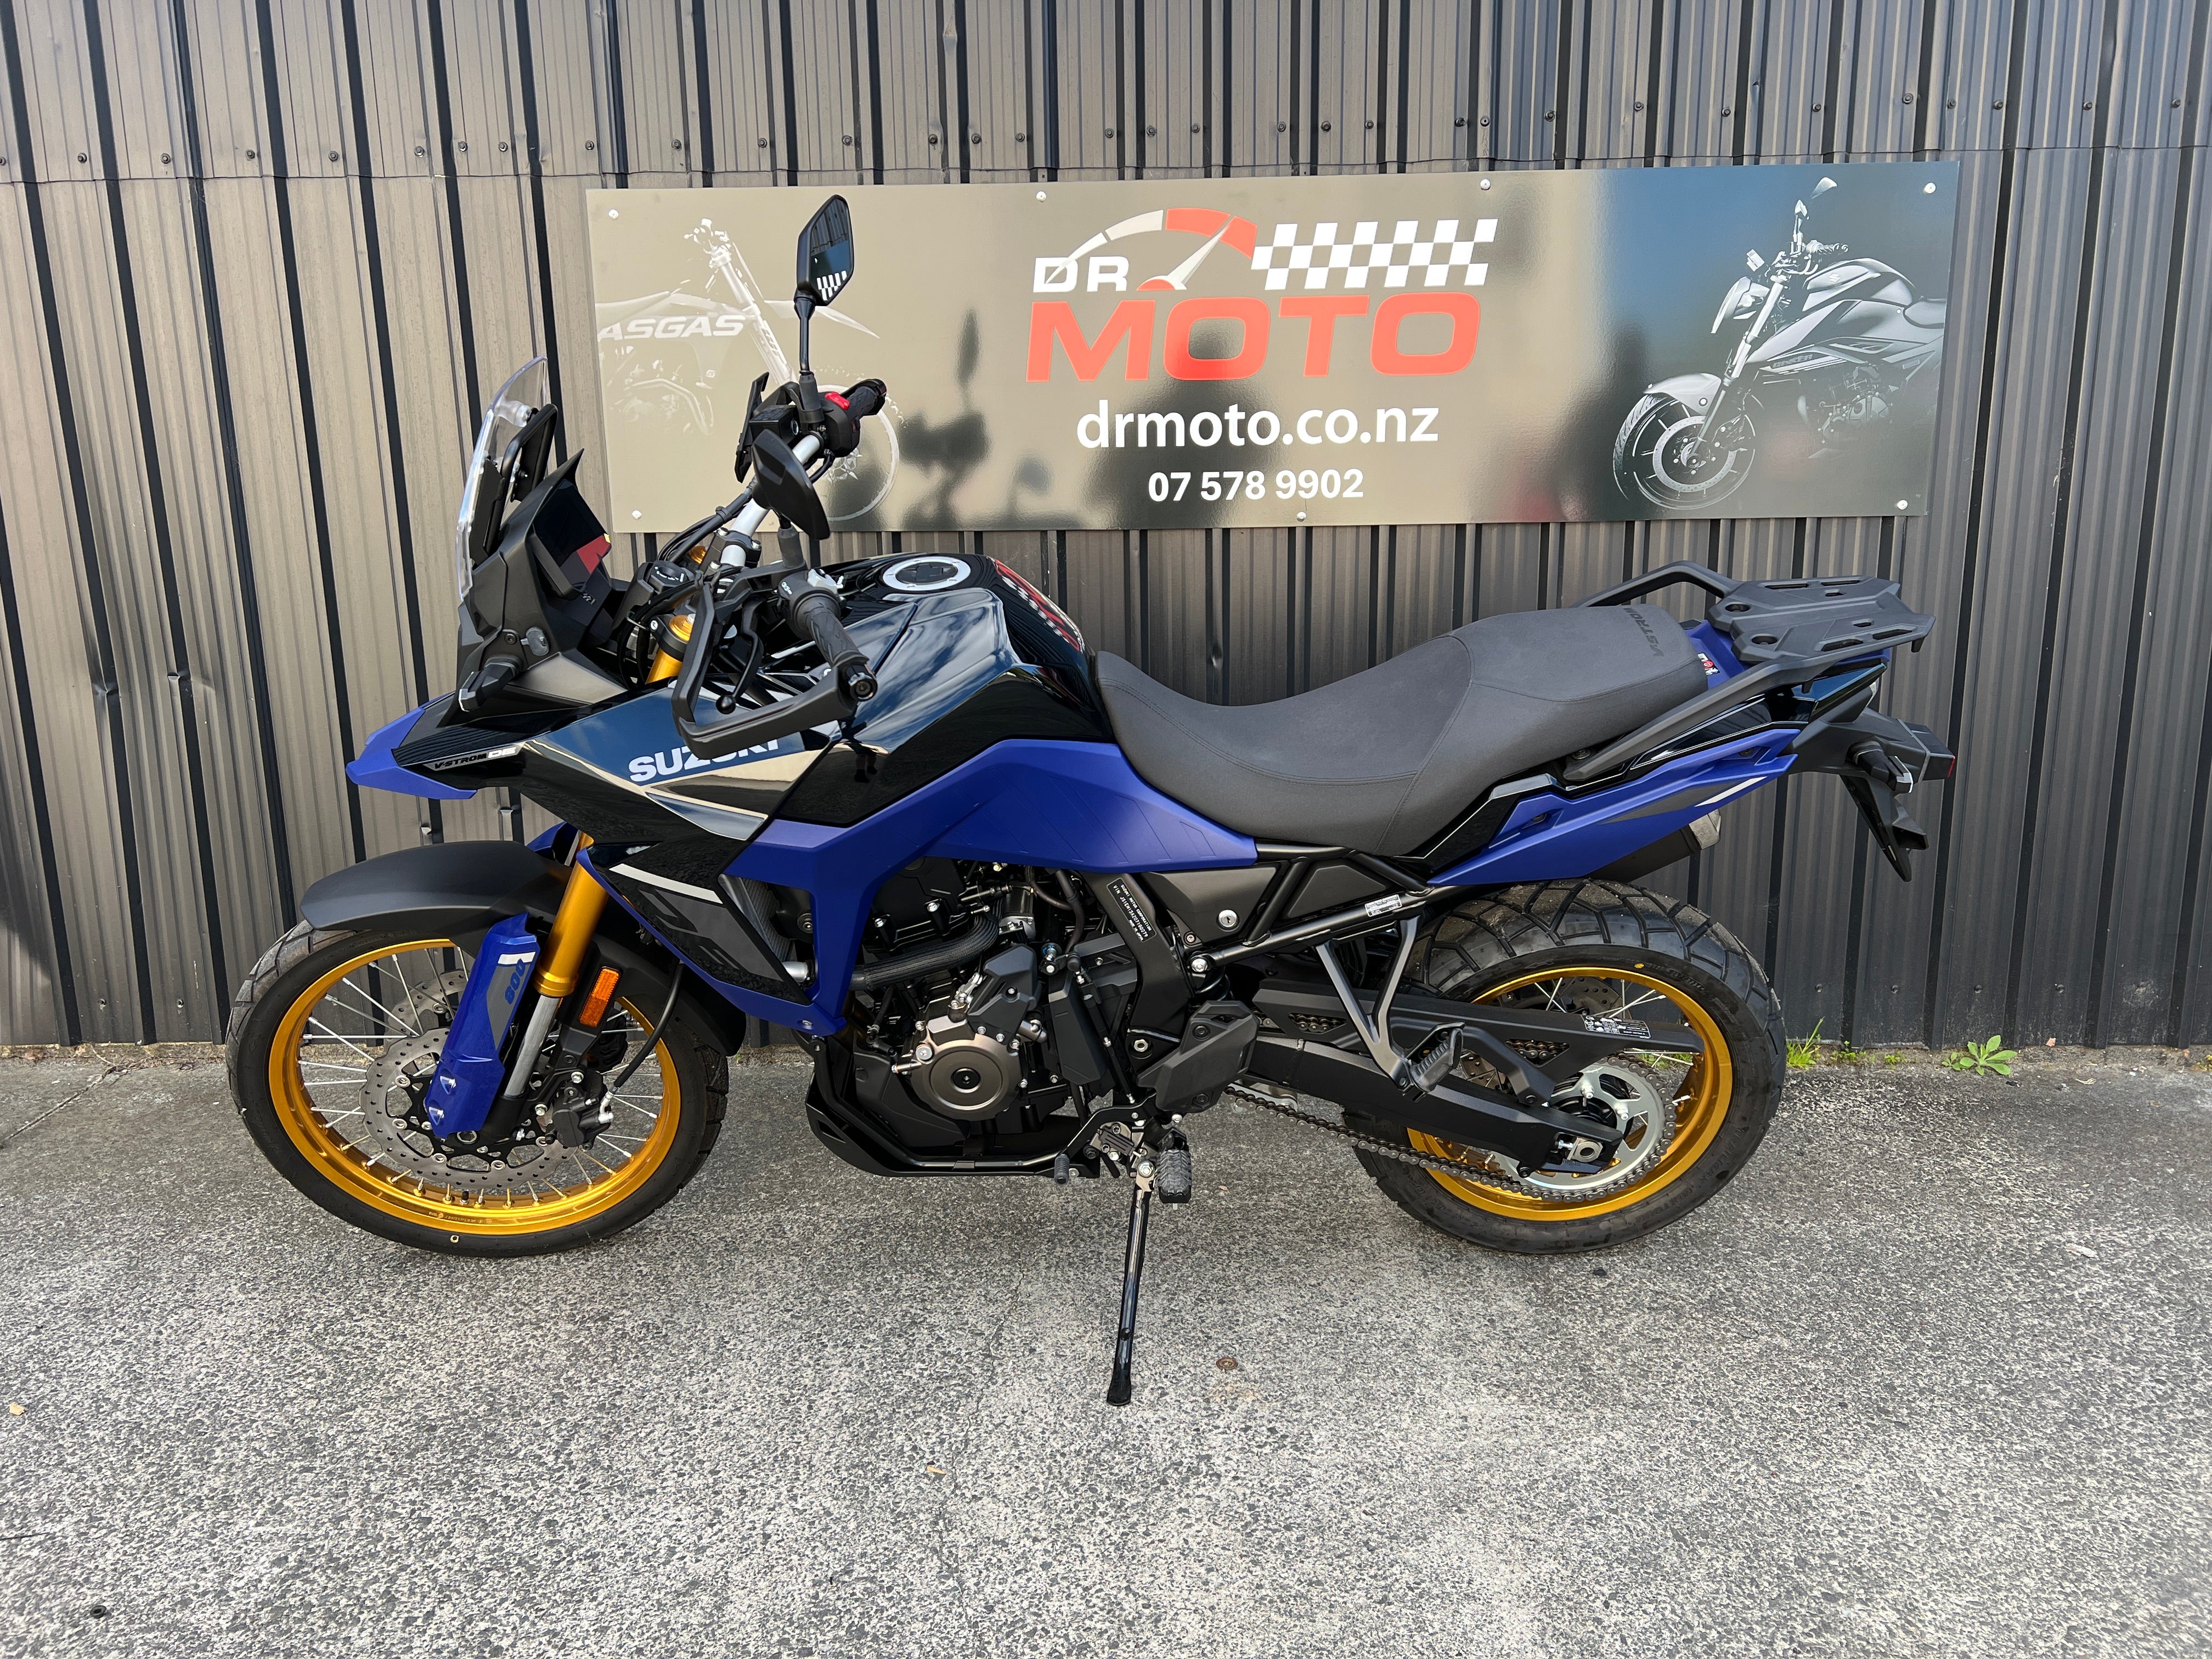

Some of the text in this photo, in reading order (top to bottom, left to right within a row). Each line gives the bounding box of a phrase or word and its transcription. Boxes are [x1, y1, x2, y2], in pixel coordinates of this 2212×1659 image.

[1032, 256, 1129, 293] DR
[1026, 291, 1481, 382] MOTO
[1076, 399, 1440, 449] drmoto.co.nz
[1148, 468, 1364, 502] 07 578 9902
[487, 747, 517, 759] DE
[628, 738, 779, 782] SUZ
[504, 958, 526, 1005] 800
